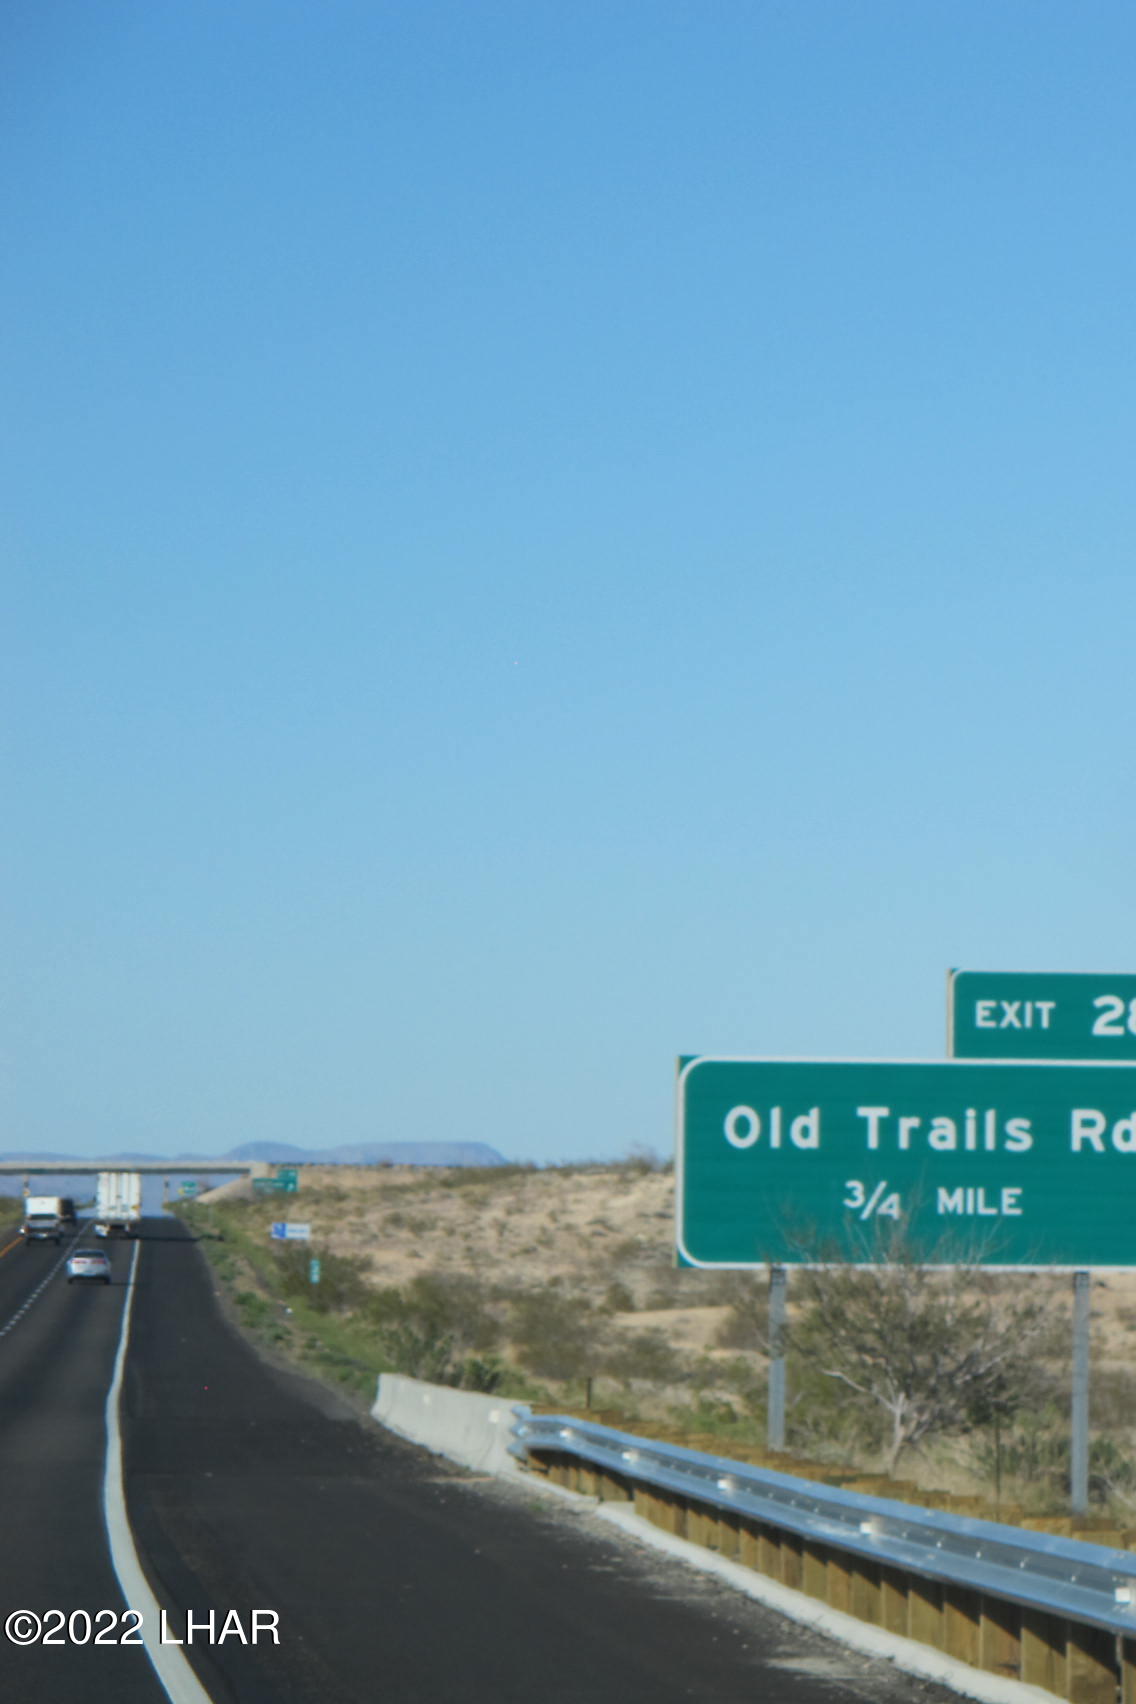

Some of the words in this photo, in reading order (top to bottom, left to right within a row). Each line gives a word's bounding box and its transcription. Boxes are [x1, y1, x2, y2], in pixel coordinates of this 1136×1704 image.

[975, 1000, 1056, 1028] EXIT
[723, 1105, 820, 1149] Old
[857, 1106, 1033, 1151] Trails
[843, 1180, 901, 1220] 3/4
[937, 1187, 1023, 1216] MILE
